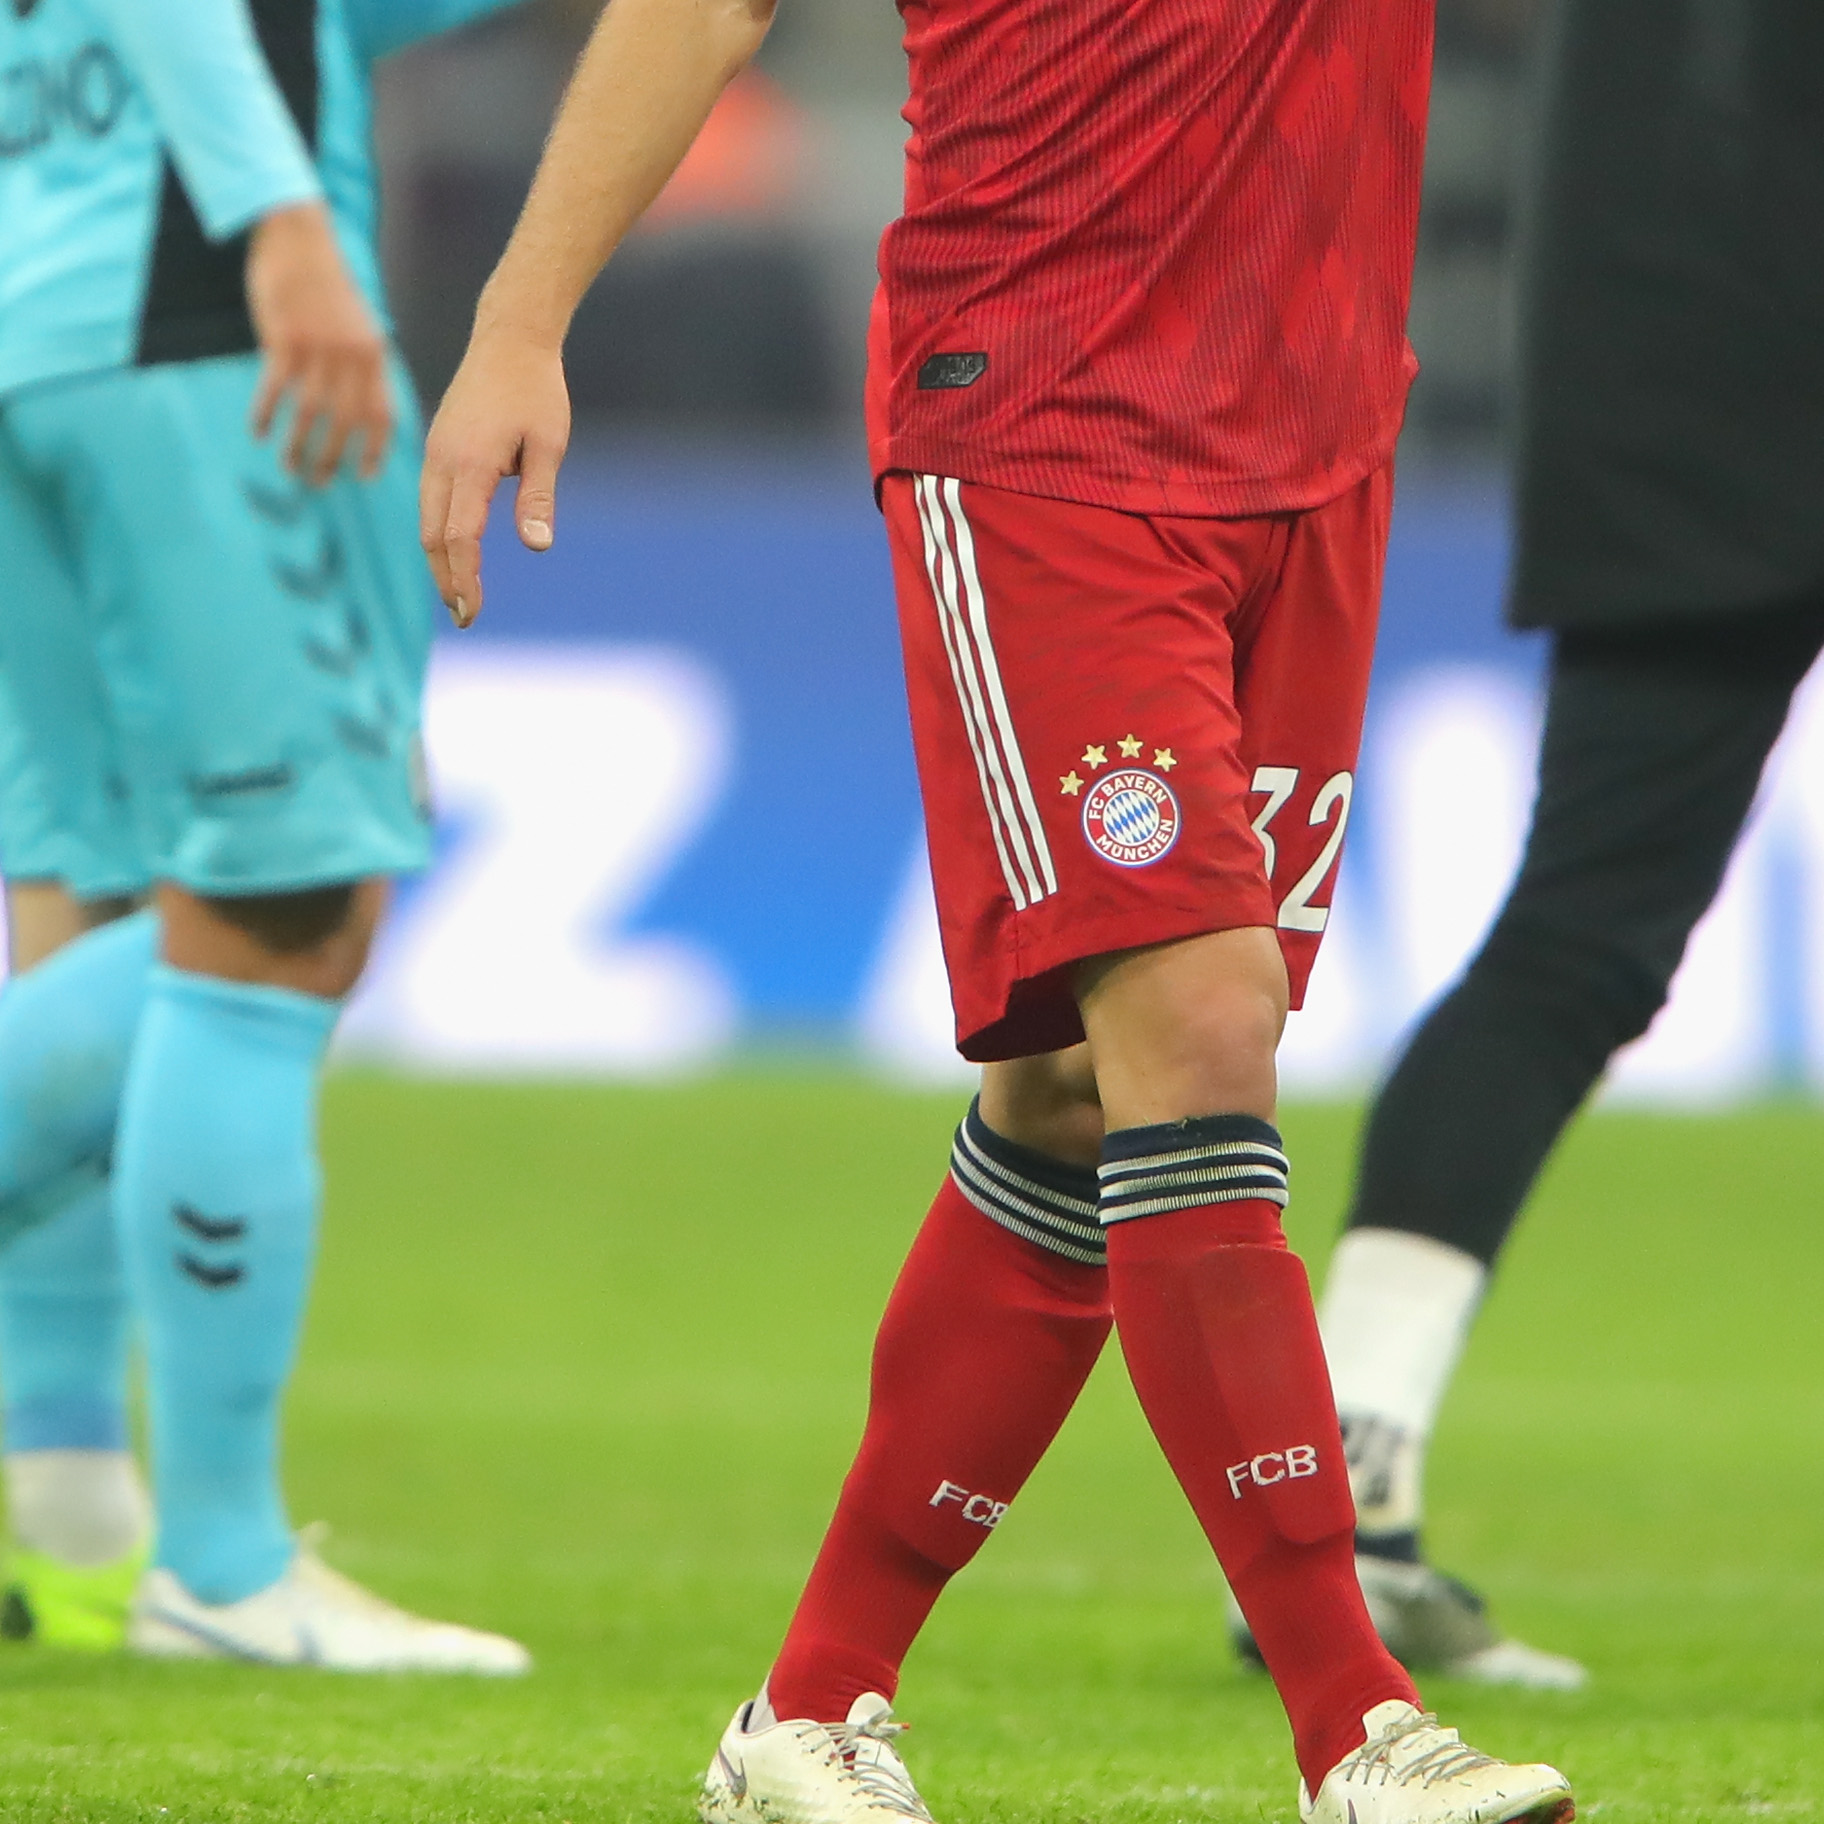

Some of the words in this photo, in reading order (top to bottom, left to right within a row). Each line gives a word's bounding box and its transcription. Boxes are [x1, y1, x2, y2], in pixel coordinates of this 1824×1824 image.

[1088, 797, 1105, 820] FC
[1101, 774, 1168, 805] BAYERN
[1251, 765, 1354, 933] 32
[1225, 1443, 1320, 1501] FCB
